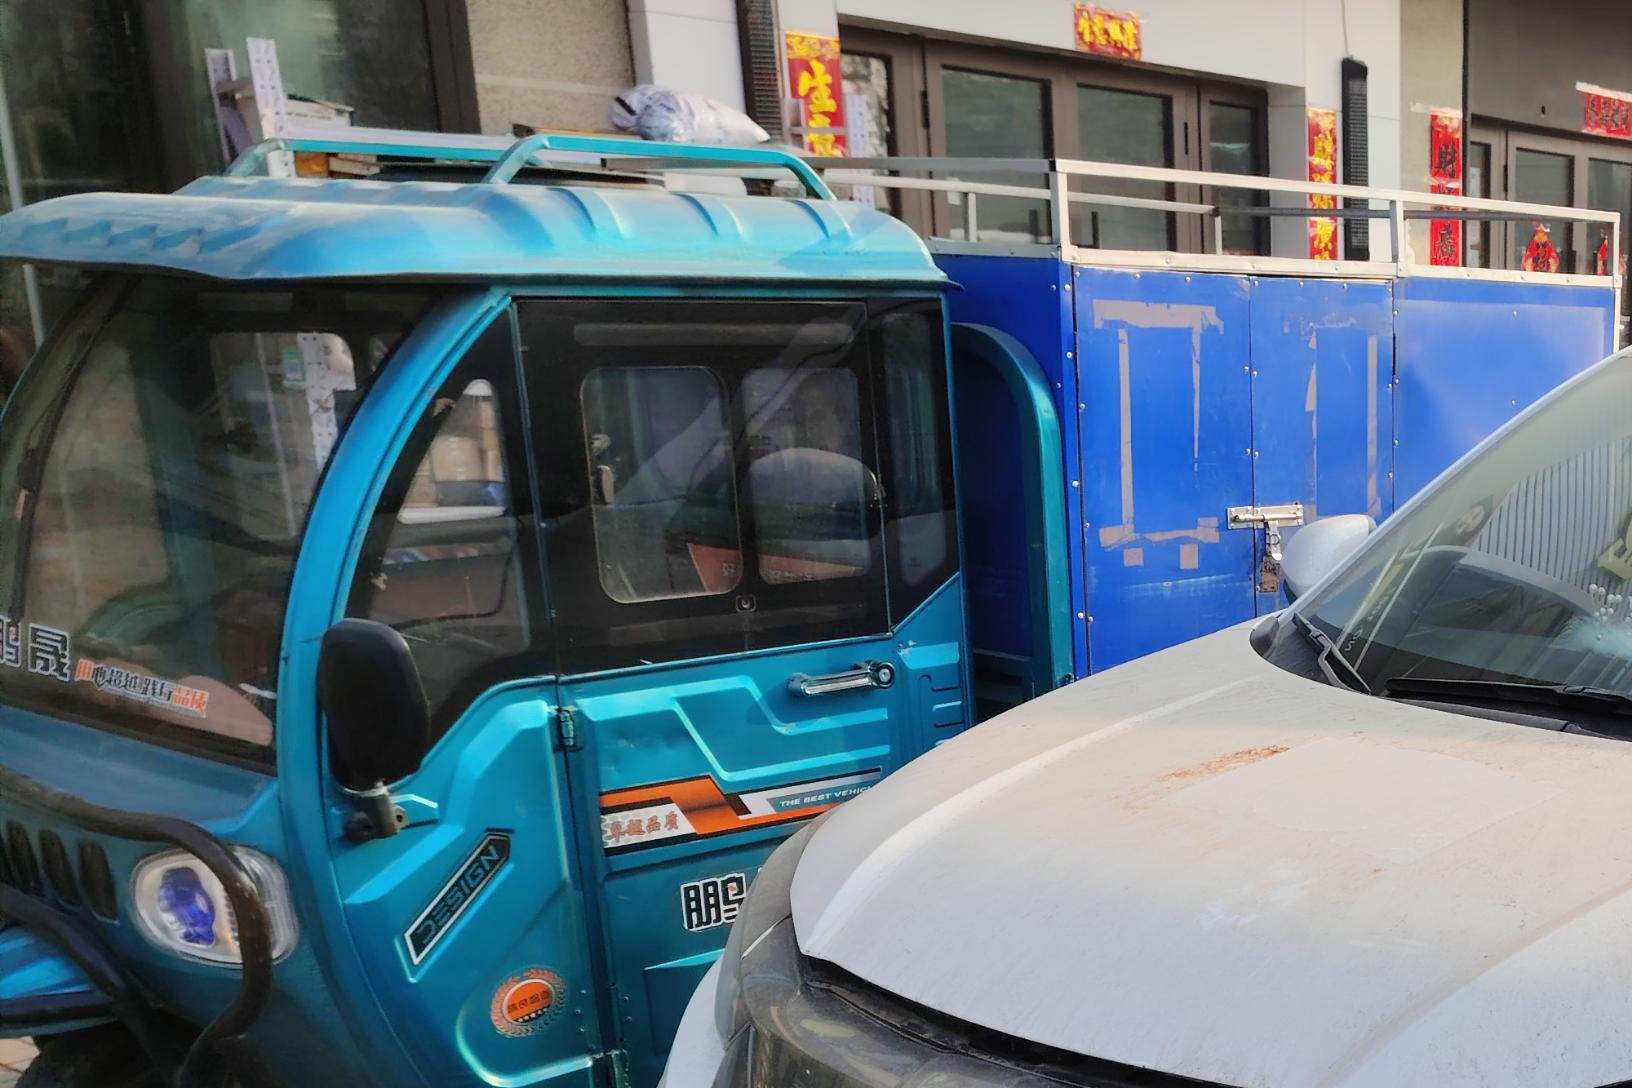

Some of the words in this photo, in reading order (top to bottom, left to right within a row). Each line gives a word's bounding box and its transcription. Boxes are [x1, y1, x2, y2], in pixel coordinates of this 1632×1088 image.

[780, 798, 801, 807] THE
[804, 793, 832, 804] BEST
[416, 844, 500, 947] DESIGN
